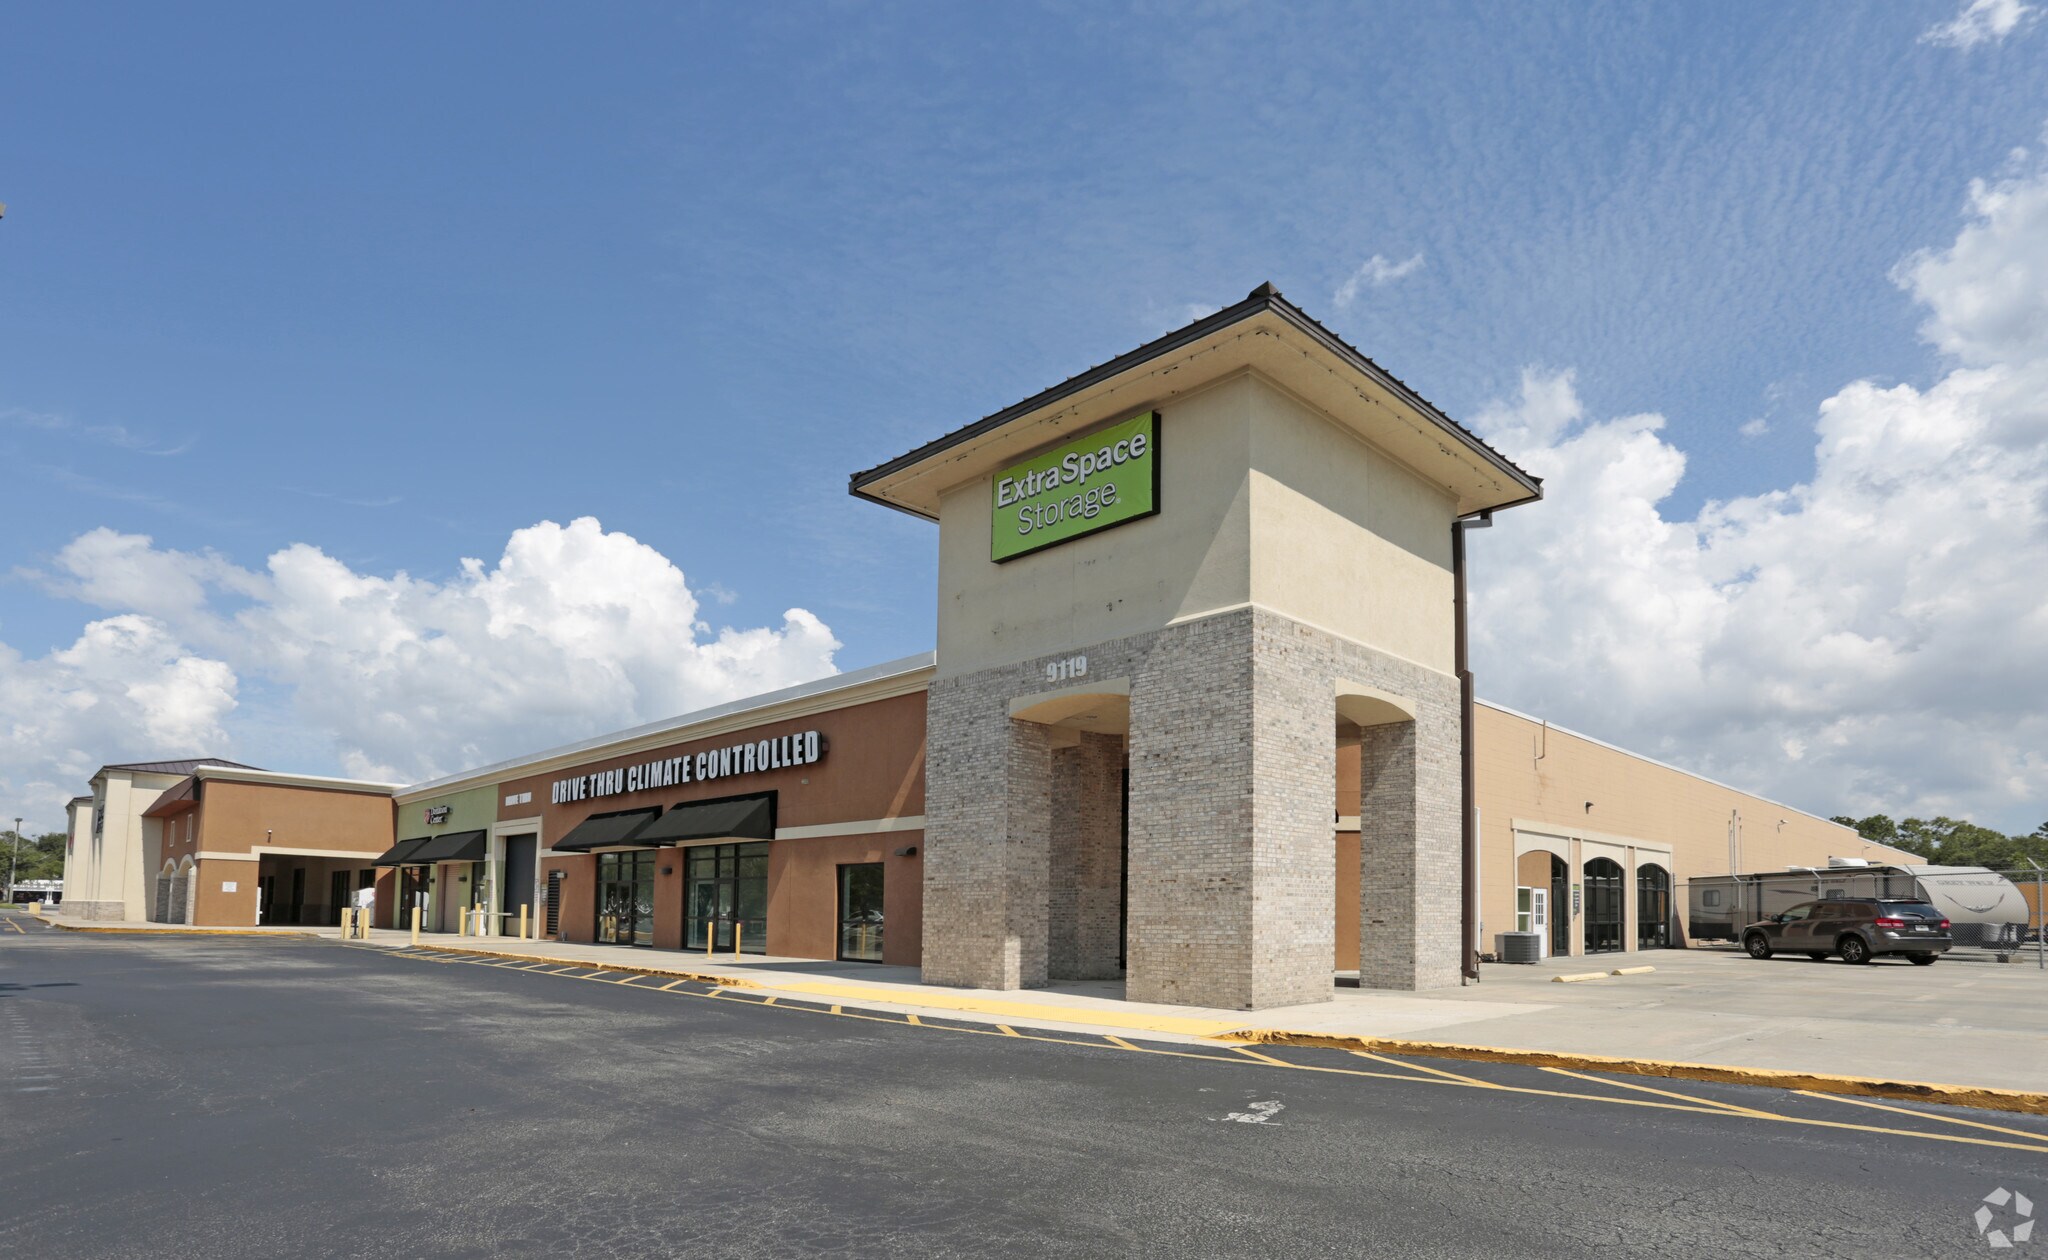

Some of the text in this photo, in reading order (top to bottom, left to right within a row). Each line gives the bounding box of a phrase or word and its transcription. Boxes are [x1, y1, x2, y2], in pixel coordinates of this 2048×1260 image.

[1018, 482, 1117, 534] Storage
[1046, 655, 1087, 682] 9119
[551, 730, 820, 804] DRIVE THRU CLIMATE CONTROLLED
